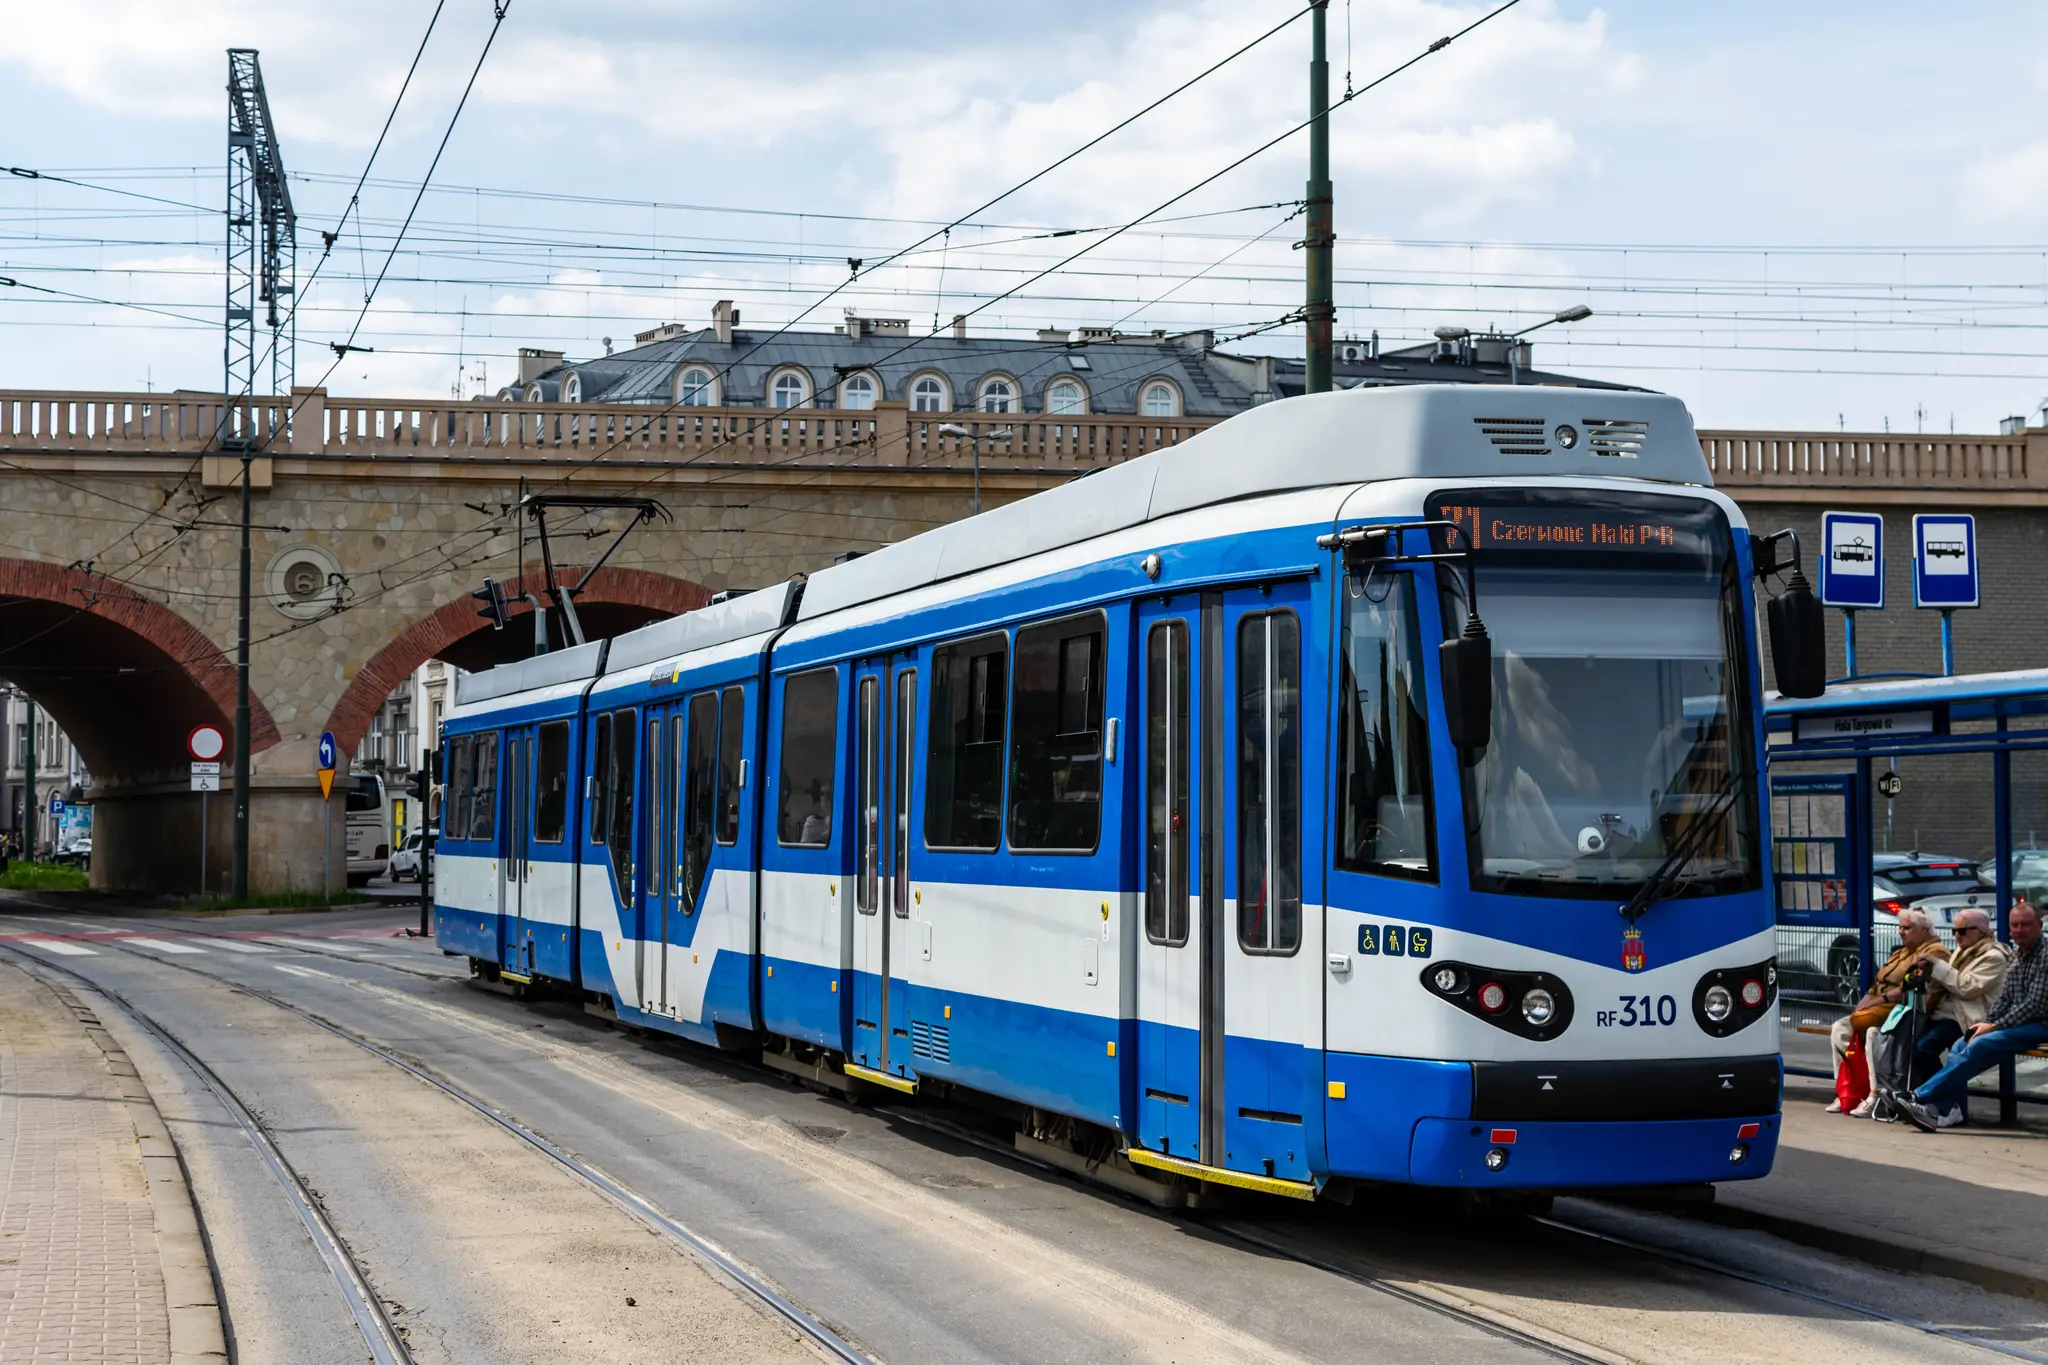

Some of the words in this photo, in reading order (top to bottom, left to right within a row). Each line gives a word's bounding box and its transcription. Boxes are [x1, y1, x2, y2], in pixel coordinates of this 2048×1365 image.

[1440, 506, 1480, 549] 71
[1492, 519, 1584, 542] Czerwone
[1592, 523, 1635, 545] Maki
[295, 573, 315, 595] 6
[1835, 719, 1851, 732] Hala
[1852, 718, 1883, 733] Targowa
[54, 801, 62, 811] P
